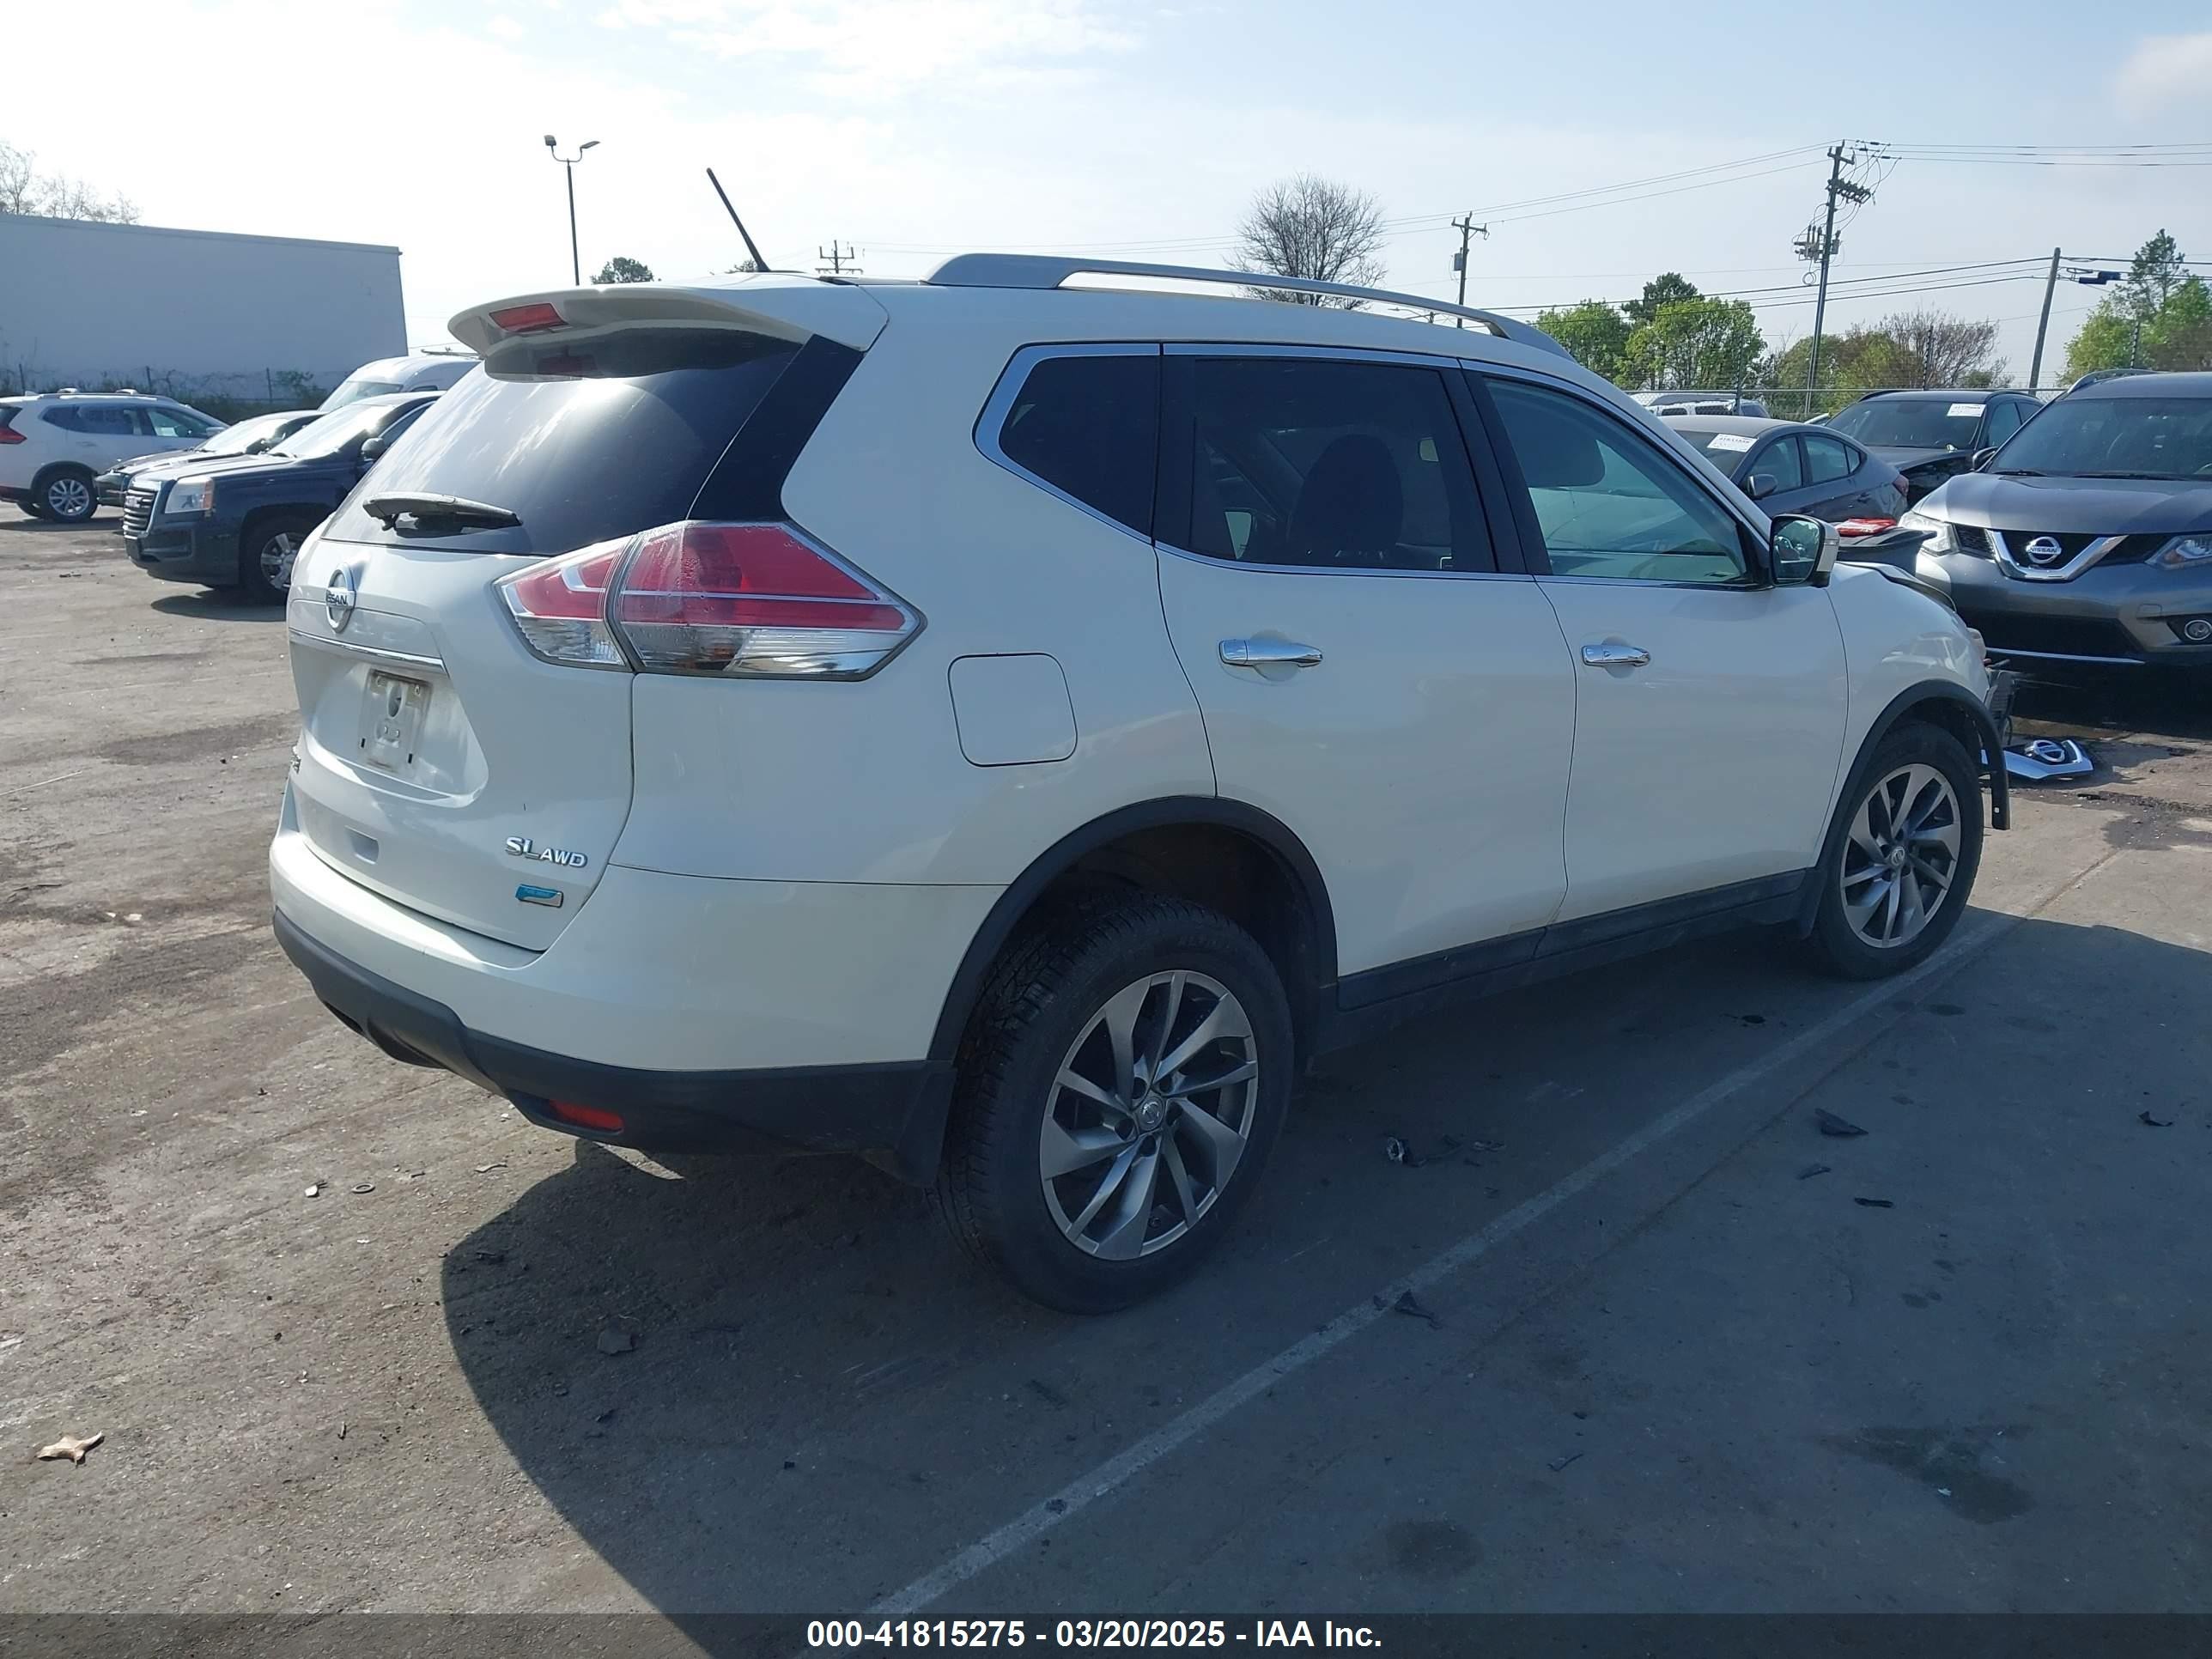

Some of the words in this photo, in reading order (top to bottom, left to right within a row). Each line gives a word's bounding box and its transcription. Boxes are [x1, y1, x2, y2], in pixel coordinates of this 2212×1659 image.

[326, 594, 348, 605] SSAN
[505, 836, 541, 859] SL
[539, 848, 588, 869] AWD
